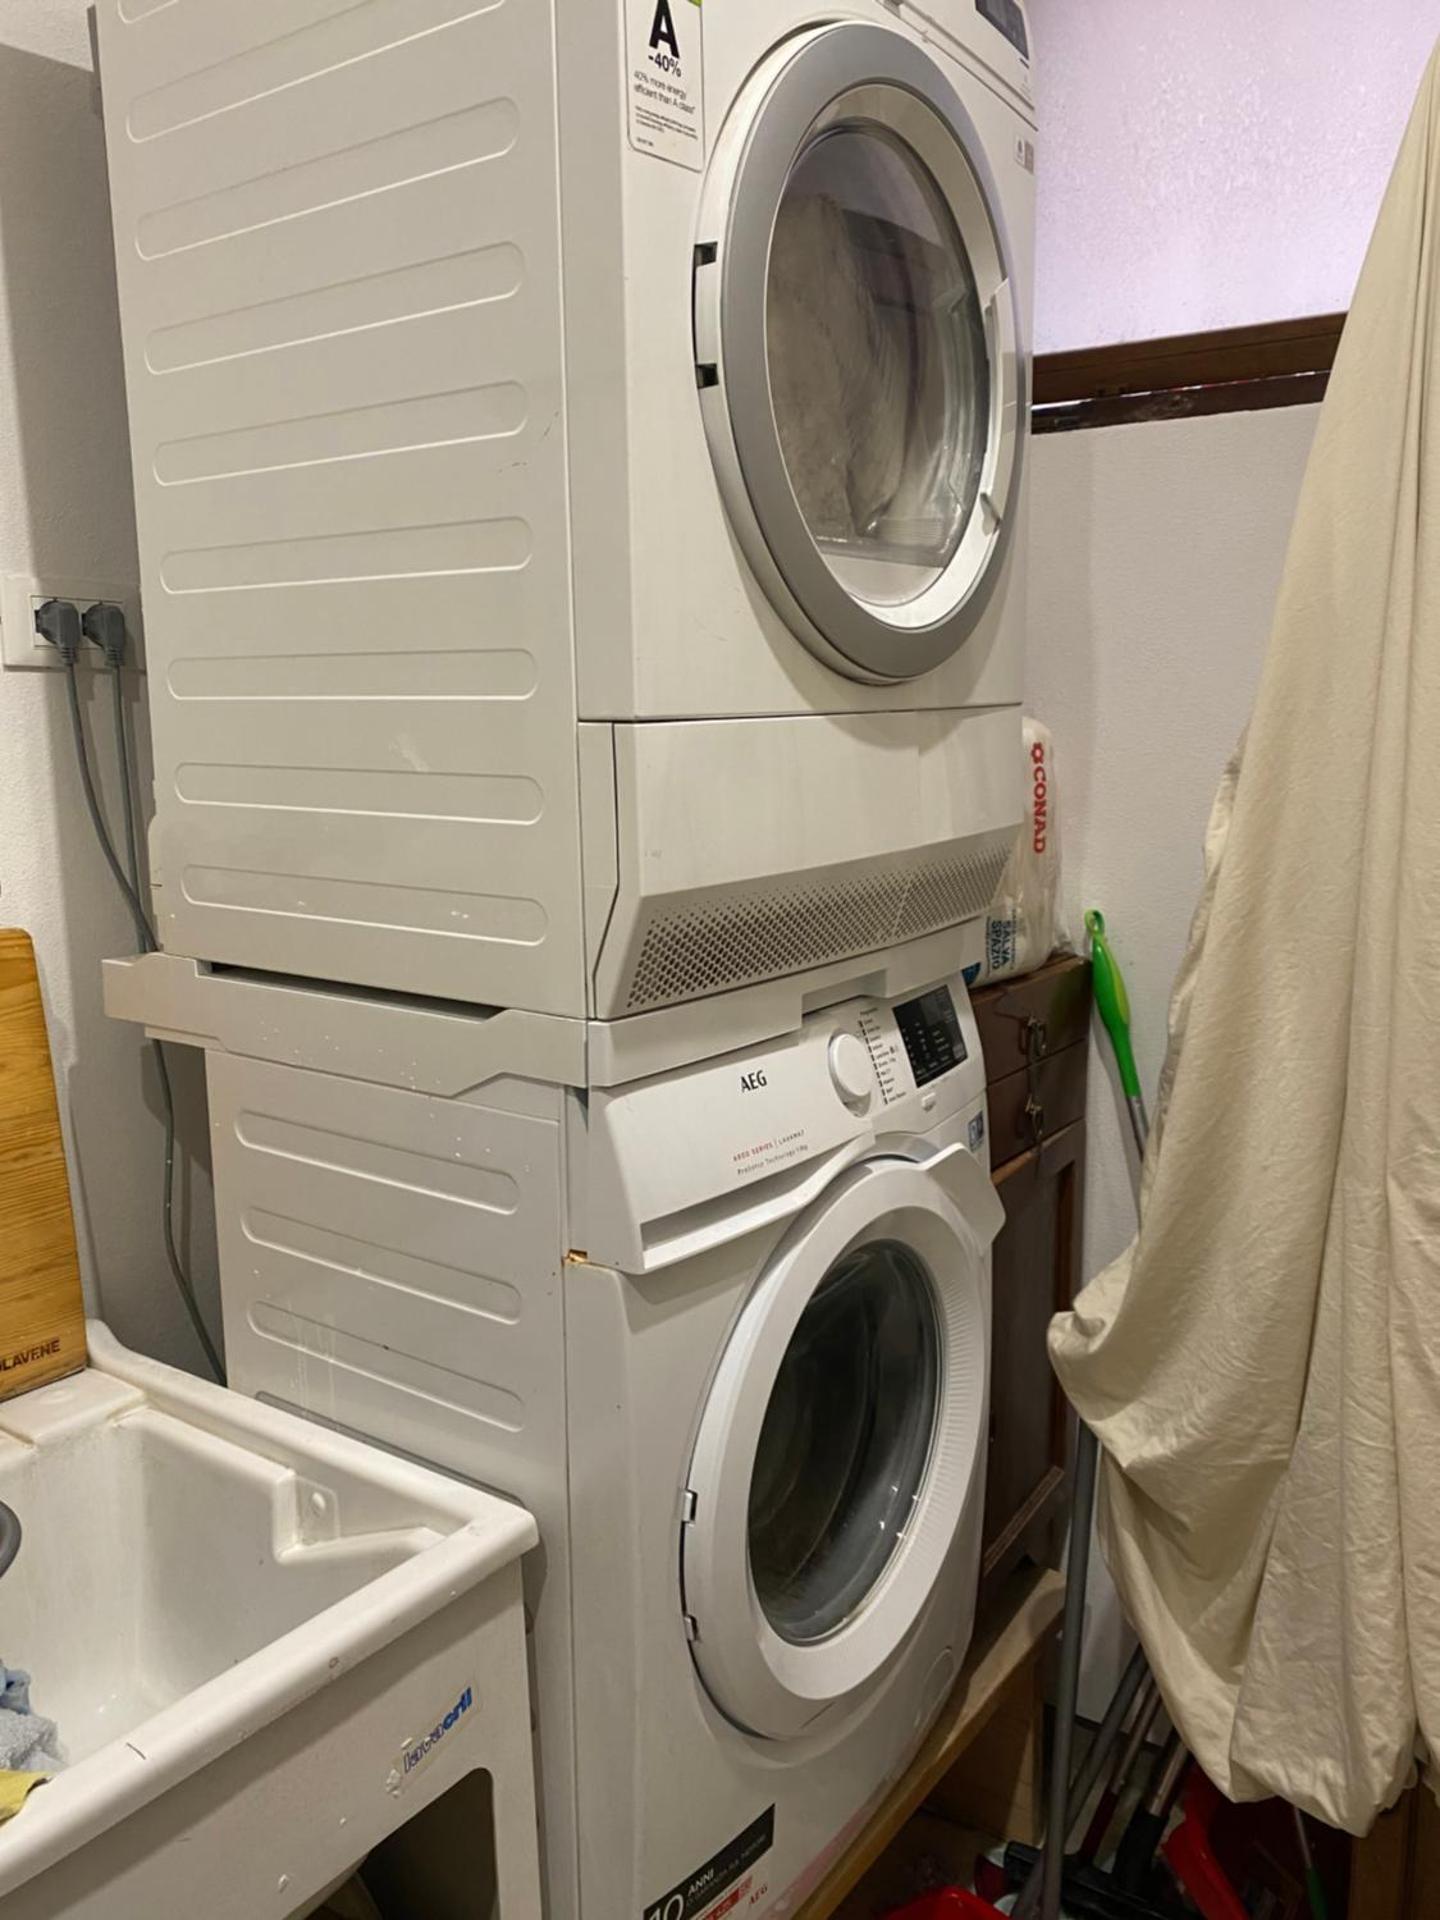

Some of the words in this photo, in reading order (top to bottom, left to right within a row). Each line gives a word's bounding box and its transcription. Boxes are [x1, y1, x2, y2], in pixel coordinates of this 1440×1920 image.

[649, 0, 680, 58] A
[648, 52, 682, 78] -40%
[1033, 765, 1047, 854] CONAD
[992, 920, 1002, 970] SPAZIO
[740, 1070, 767, 1093] AEG
[688, 1867, 714, 1897] ANNI
